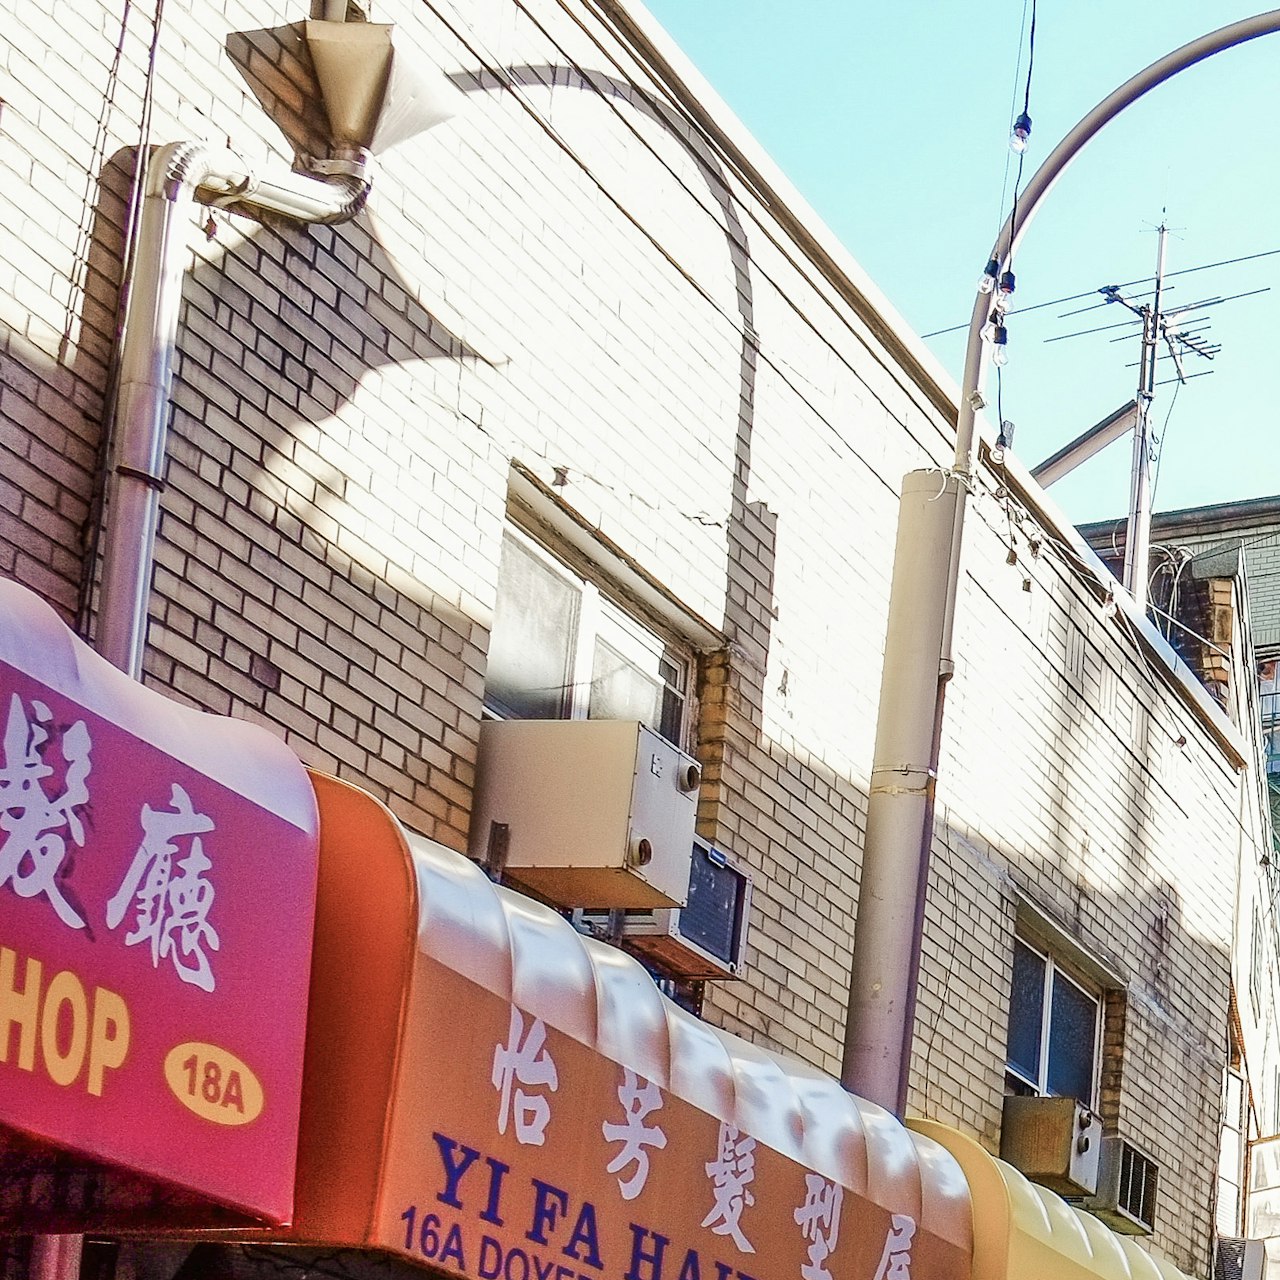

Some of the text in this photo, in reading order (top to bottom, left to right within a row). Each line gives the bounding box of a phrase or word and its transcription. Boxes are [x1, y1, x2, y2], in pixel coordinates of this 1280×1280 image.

[181, 1053, 246, 1116] 18A
[432, 1132, 510, 1227] YI
[526, 1178, 604, 1270] FA
[401, 1206, 465, 1271] 16A
